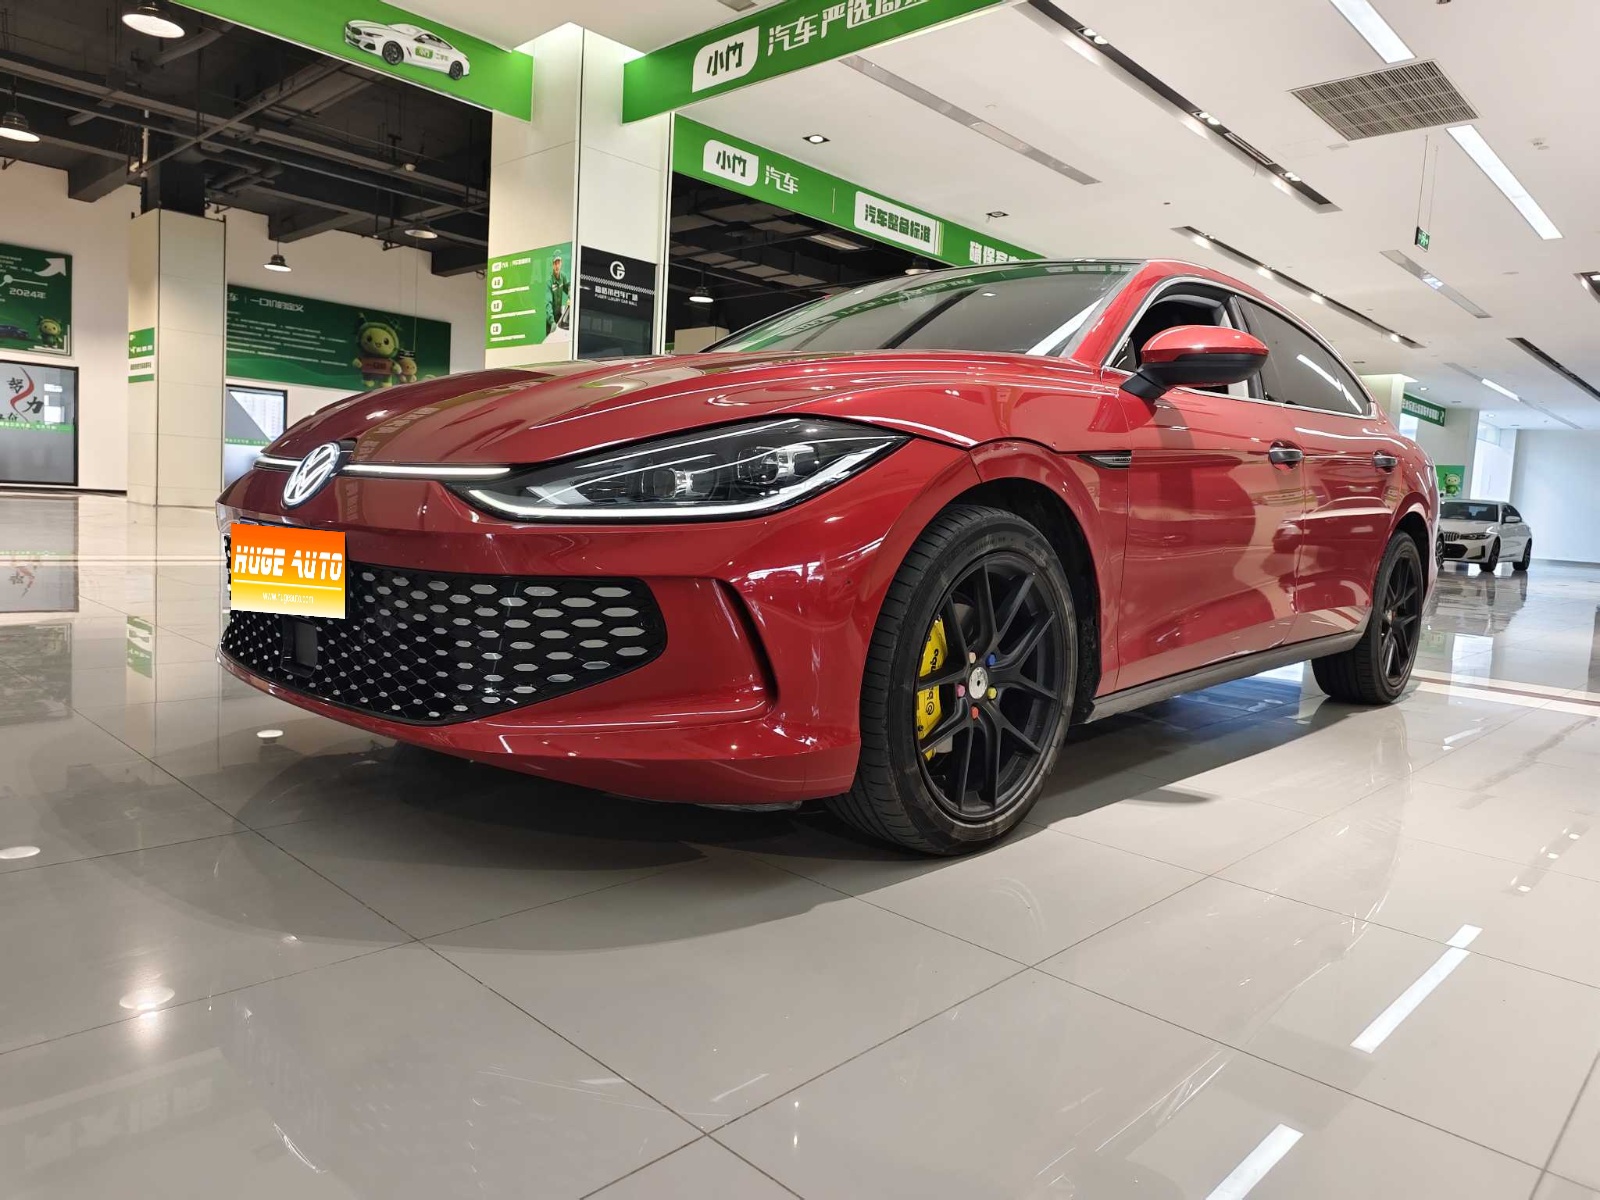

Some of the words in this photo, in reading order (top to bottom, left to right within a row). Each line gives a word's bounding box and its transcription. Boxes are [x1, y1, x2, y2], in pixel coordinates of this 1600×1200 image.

[706, 41, 744, 76] 小竹
[715, 150, 747, 177] 小竹
[764, 165, 799, 194] 汽车
